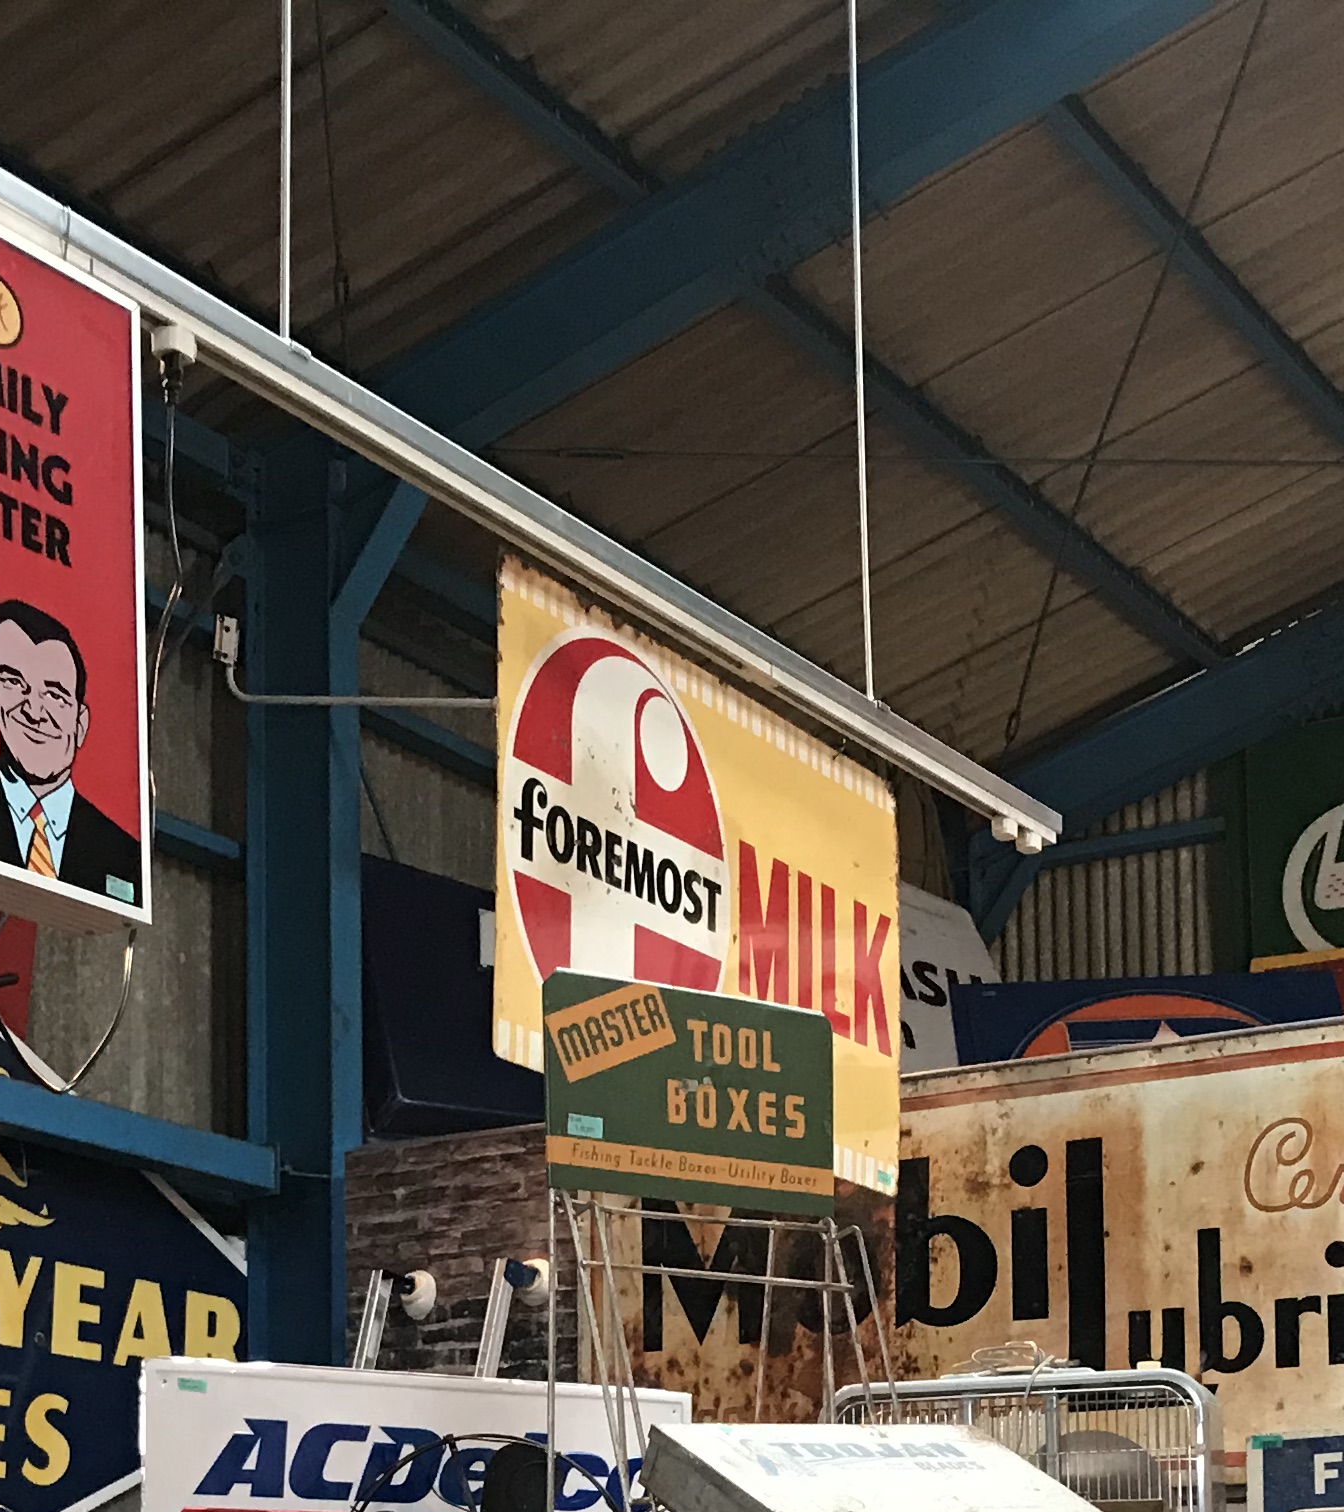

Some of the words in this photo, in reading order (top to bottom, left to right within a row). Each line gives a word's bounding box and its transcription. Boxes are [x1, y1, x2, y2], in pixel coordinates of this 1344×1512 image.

[738, 839, 893, 1058] MILK
[557, 992, 668, 1068] MASTER
[686, 1020, 782, 1072] TOOL
[666, 1078, 806, 1138] BOXES
[572, 1143, 621, 1168] Fishing
[630, 1150, 673, 1171] Tackle
[767, 1442, 967, 1458] TROJAN
